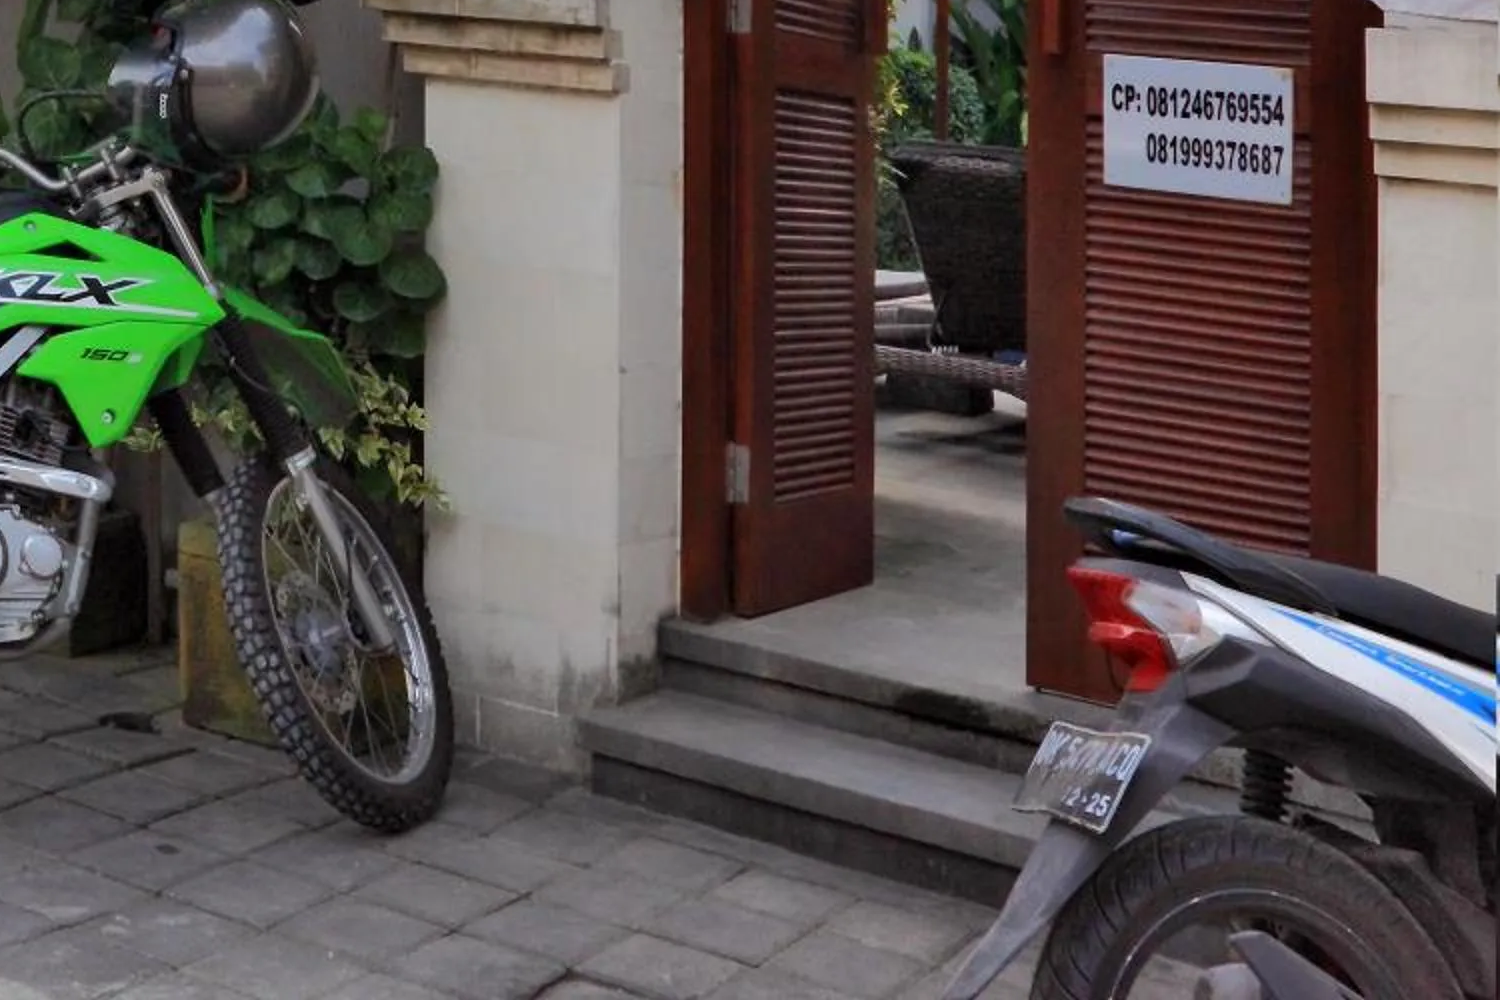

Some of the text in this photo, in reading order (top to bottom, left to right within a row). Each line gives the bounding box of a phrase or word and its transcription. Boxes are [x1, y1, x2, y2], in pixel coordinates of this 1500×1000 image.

[1111, 83, 1284, 126] CP: 081246769554
[1146, 133, 1284, 176] 081999378687
[80, 347, 130, 361] 150
